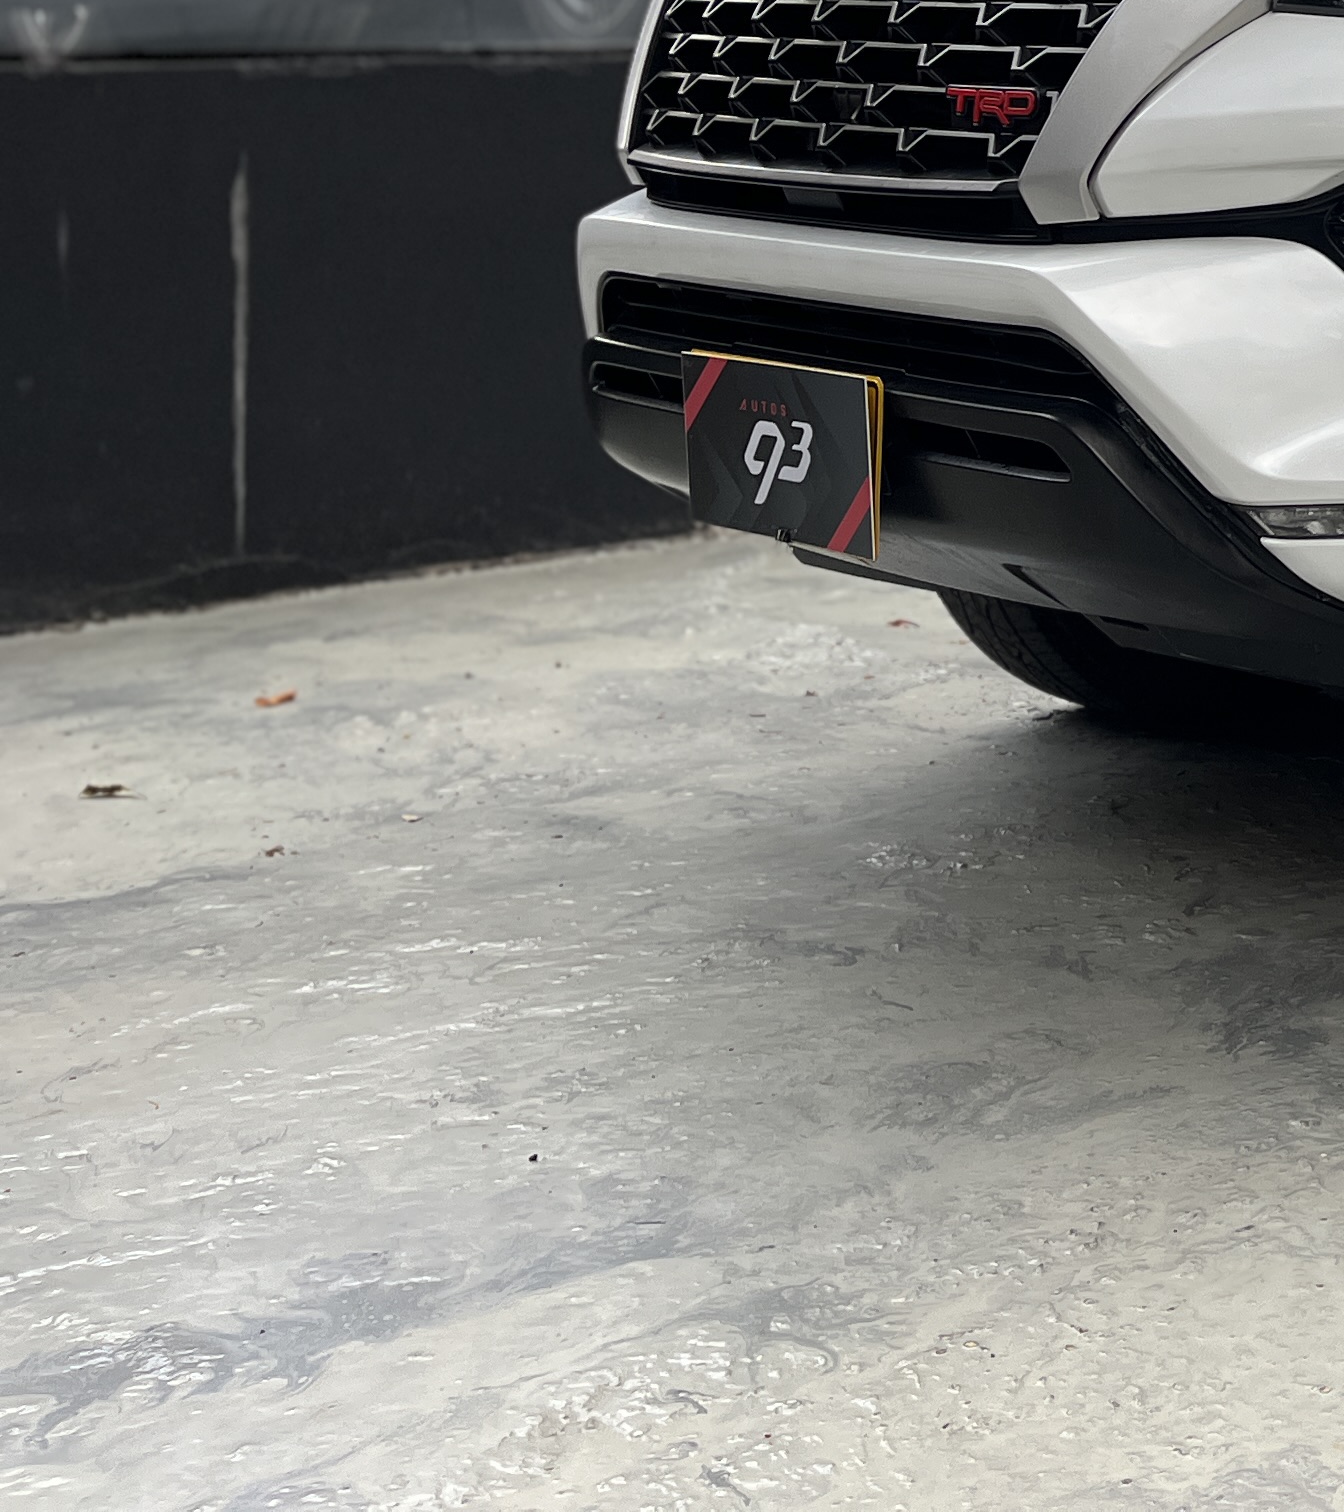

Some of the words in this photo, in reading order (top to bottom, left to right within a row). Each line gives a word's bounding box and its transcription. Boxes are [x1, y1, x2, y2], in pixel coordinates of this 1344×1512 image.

[946, 86, 1037, 126] TRD
[739, 398, 788, 417] AUTOS
[744, 420, 813, 505] 93
